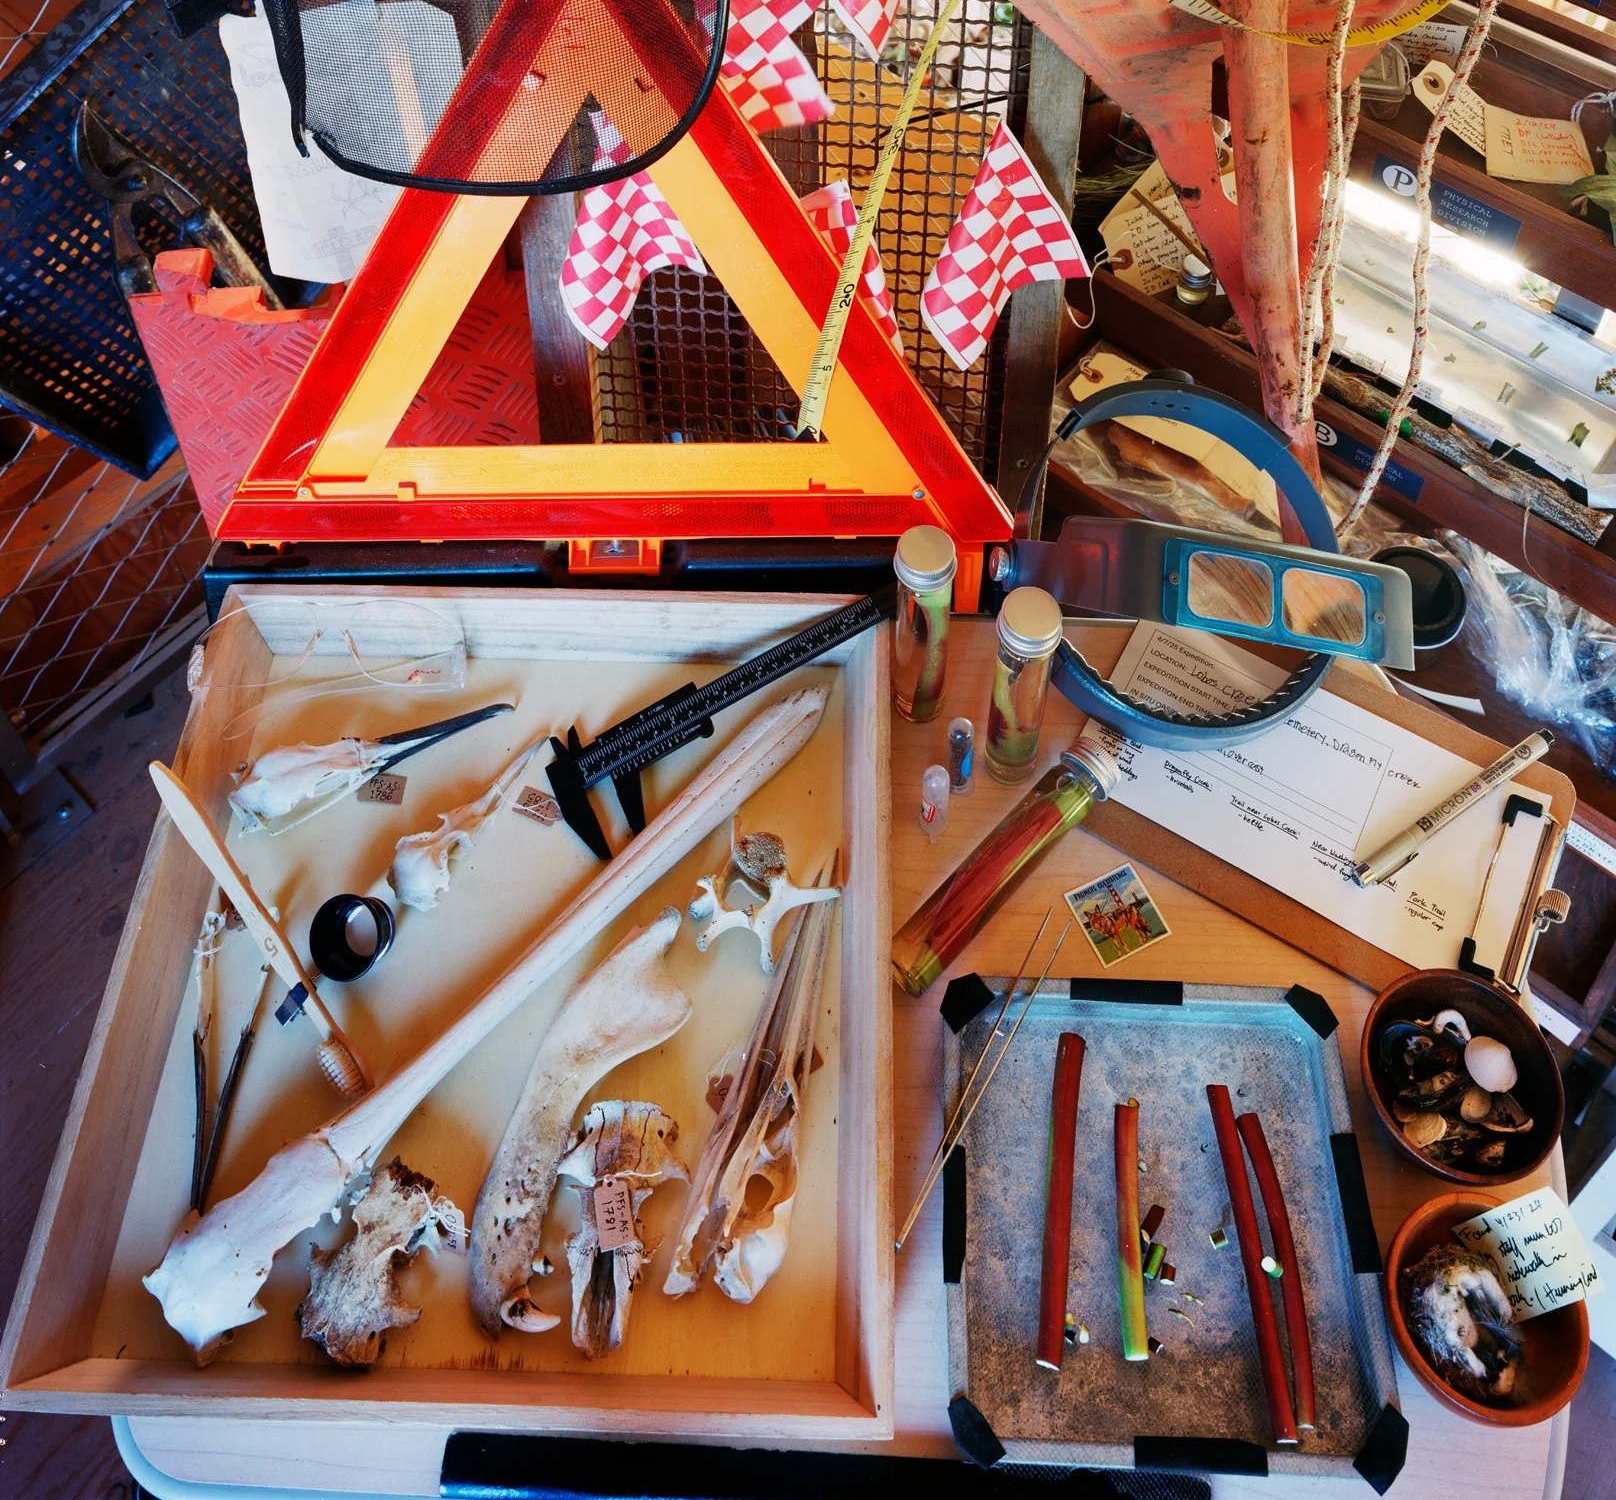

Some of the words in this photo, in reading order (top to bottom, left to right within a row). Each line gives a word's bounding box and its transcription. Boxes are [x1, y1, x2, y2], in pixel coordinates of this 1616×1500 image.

[1390, 167, 1414, 192] P
[1440, 199, 1490, 228] RESEARCH
[1443, 189, 1493, 218] PHYSICAL
[1437, 208, 1487, 237] DIVISION
[1315, 421, 1330, 443] B
[1150, 649, 1188, 672] LOCATION:
[1156, 635, 1180, 652] 4/7/25
[1178, 647, 1216, 670] Expedition.
[1129, 687, 1139, 697] IN
[1136, 674, 1180, 703] EXPEDITION
[1178, 695, 1196, 710] END
[1191, 685, 1214, 701] START
[1212, 696, 1232, 711] TIME:
[370, 789, 394, 801] 1786
[1230, 795, 1246, 808] Trail
[1429, 787, 1473, 824] MICRON
[1311, 840, 1328, 853] Near
[1329, 848, 1358, 869] Washingto
[1408, 890, 1428, 908] Park
[1430, 902, 1448, 918] Trail
[601, 1200, 617, 1231] 1781
[614, 1190, 629, 1239] PFS-AS:
[1459, 1217, 1494, 1243] Found
